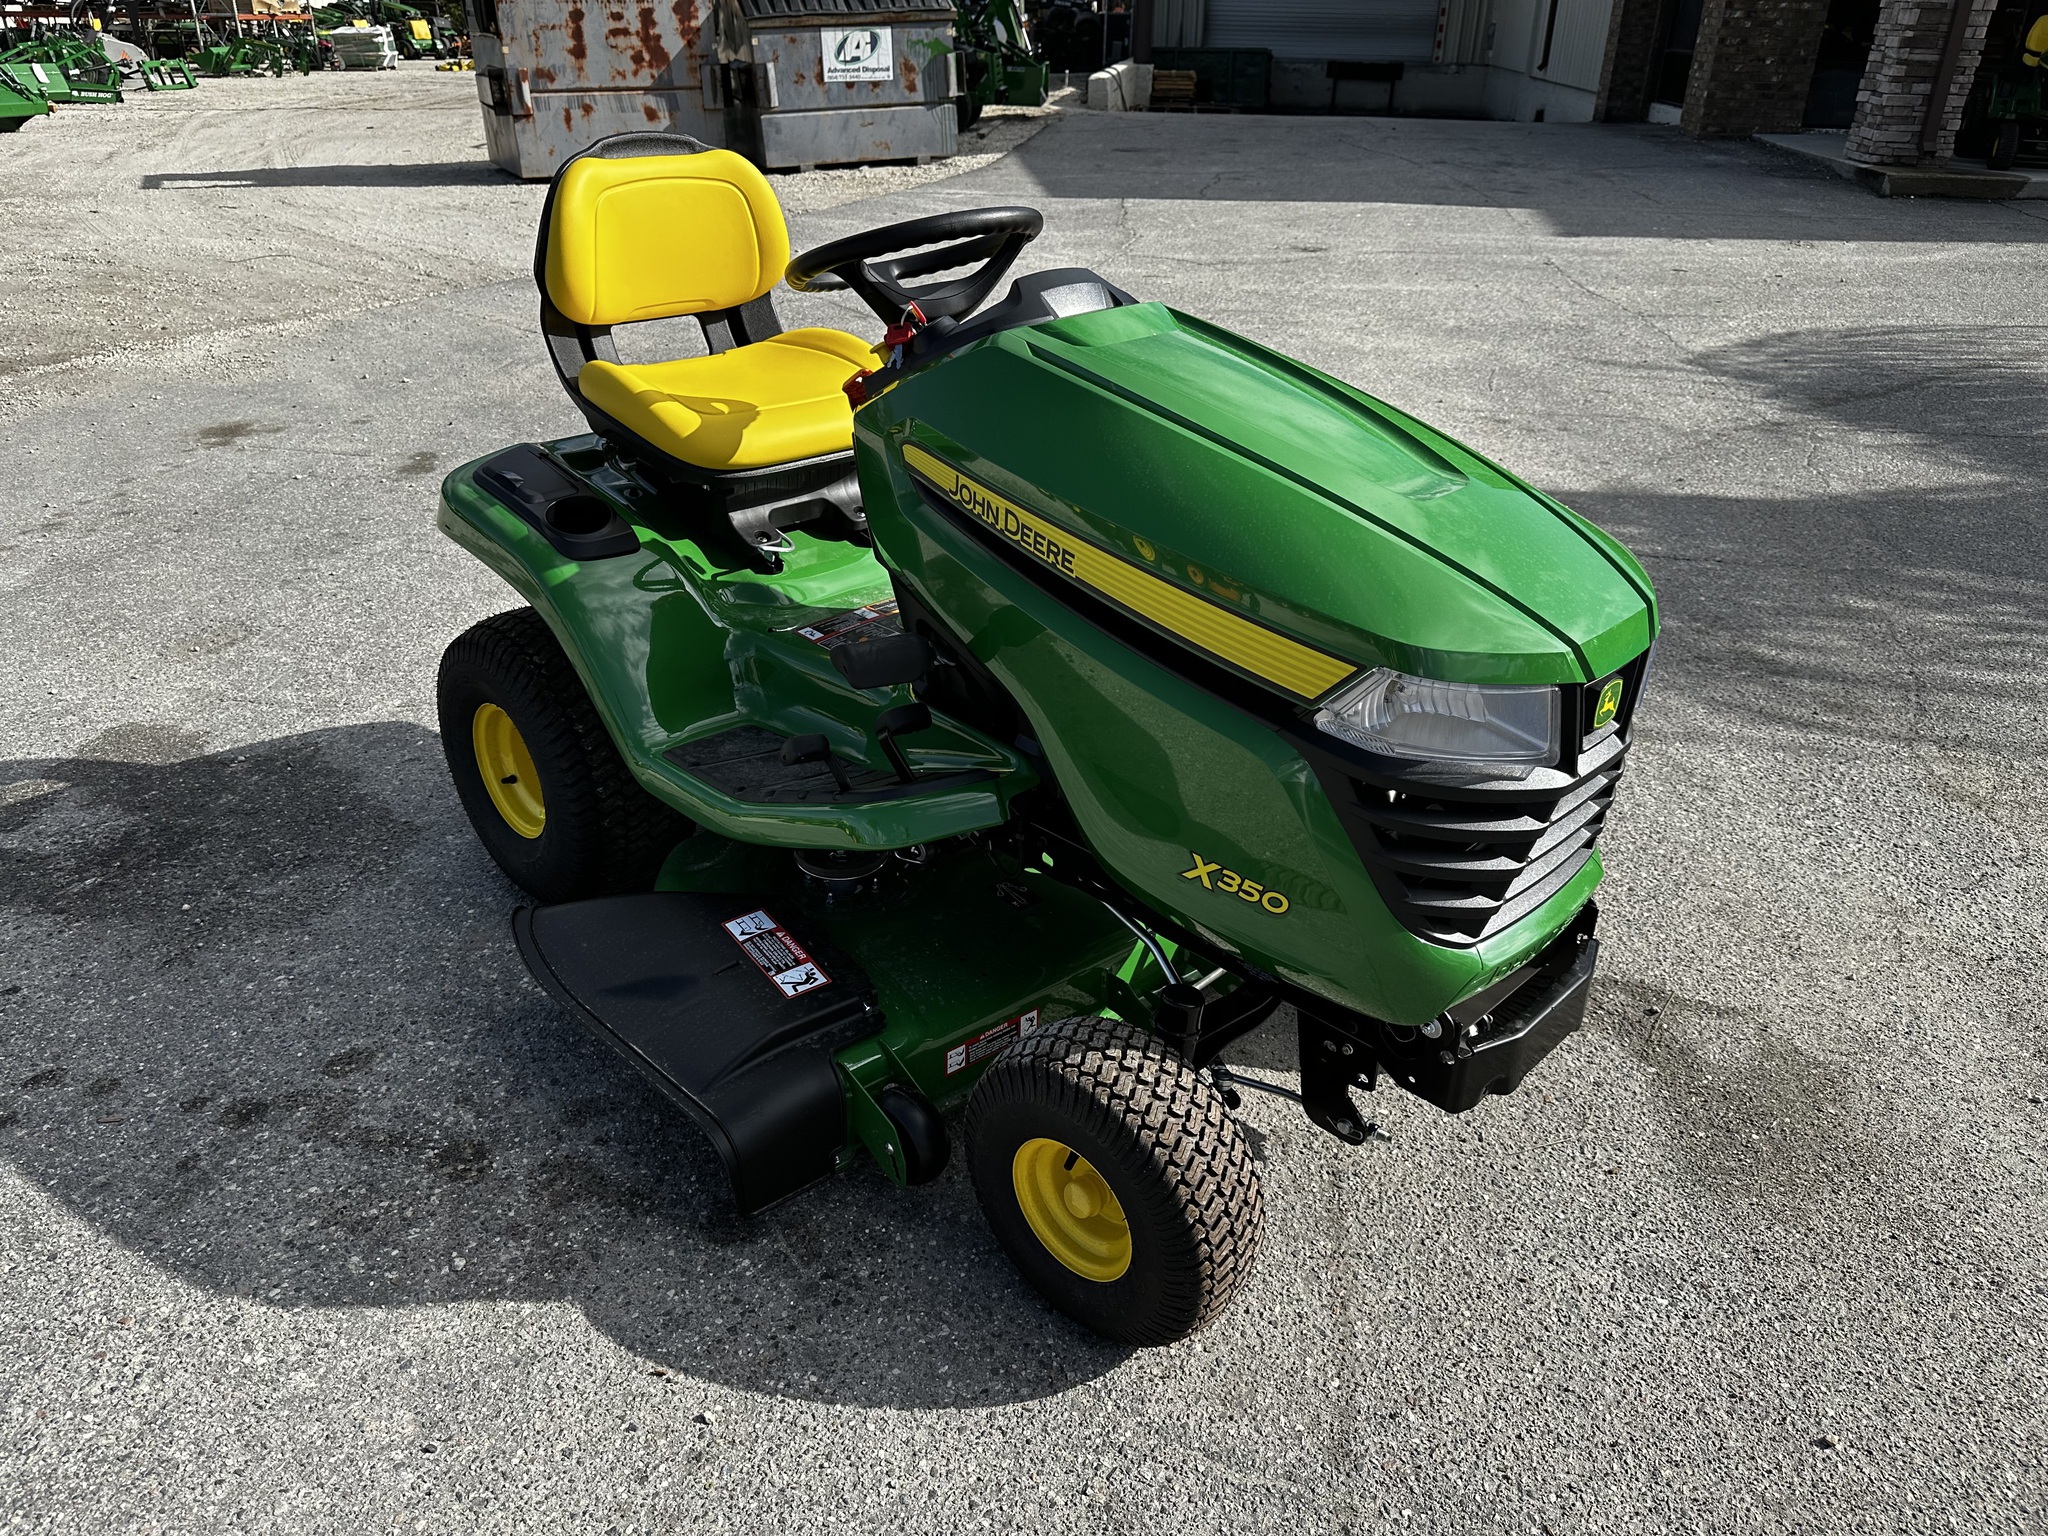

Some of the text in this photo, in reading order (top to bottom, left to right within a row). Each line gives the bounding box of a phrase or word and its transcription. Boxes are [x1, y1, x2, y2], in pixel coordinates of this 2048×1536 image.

[827, 65, 891, 75] Advanced Disposal
[948, 474, 1076, 578] JOHN DEERE
[1179, 850, 1290, 914] X350
[781, 936, 807, 960] DANGER
[985, 1023, 1009, 1038] DANGER
